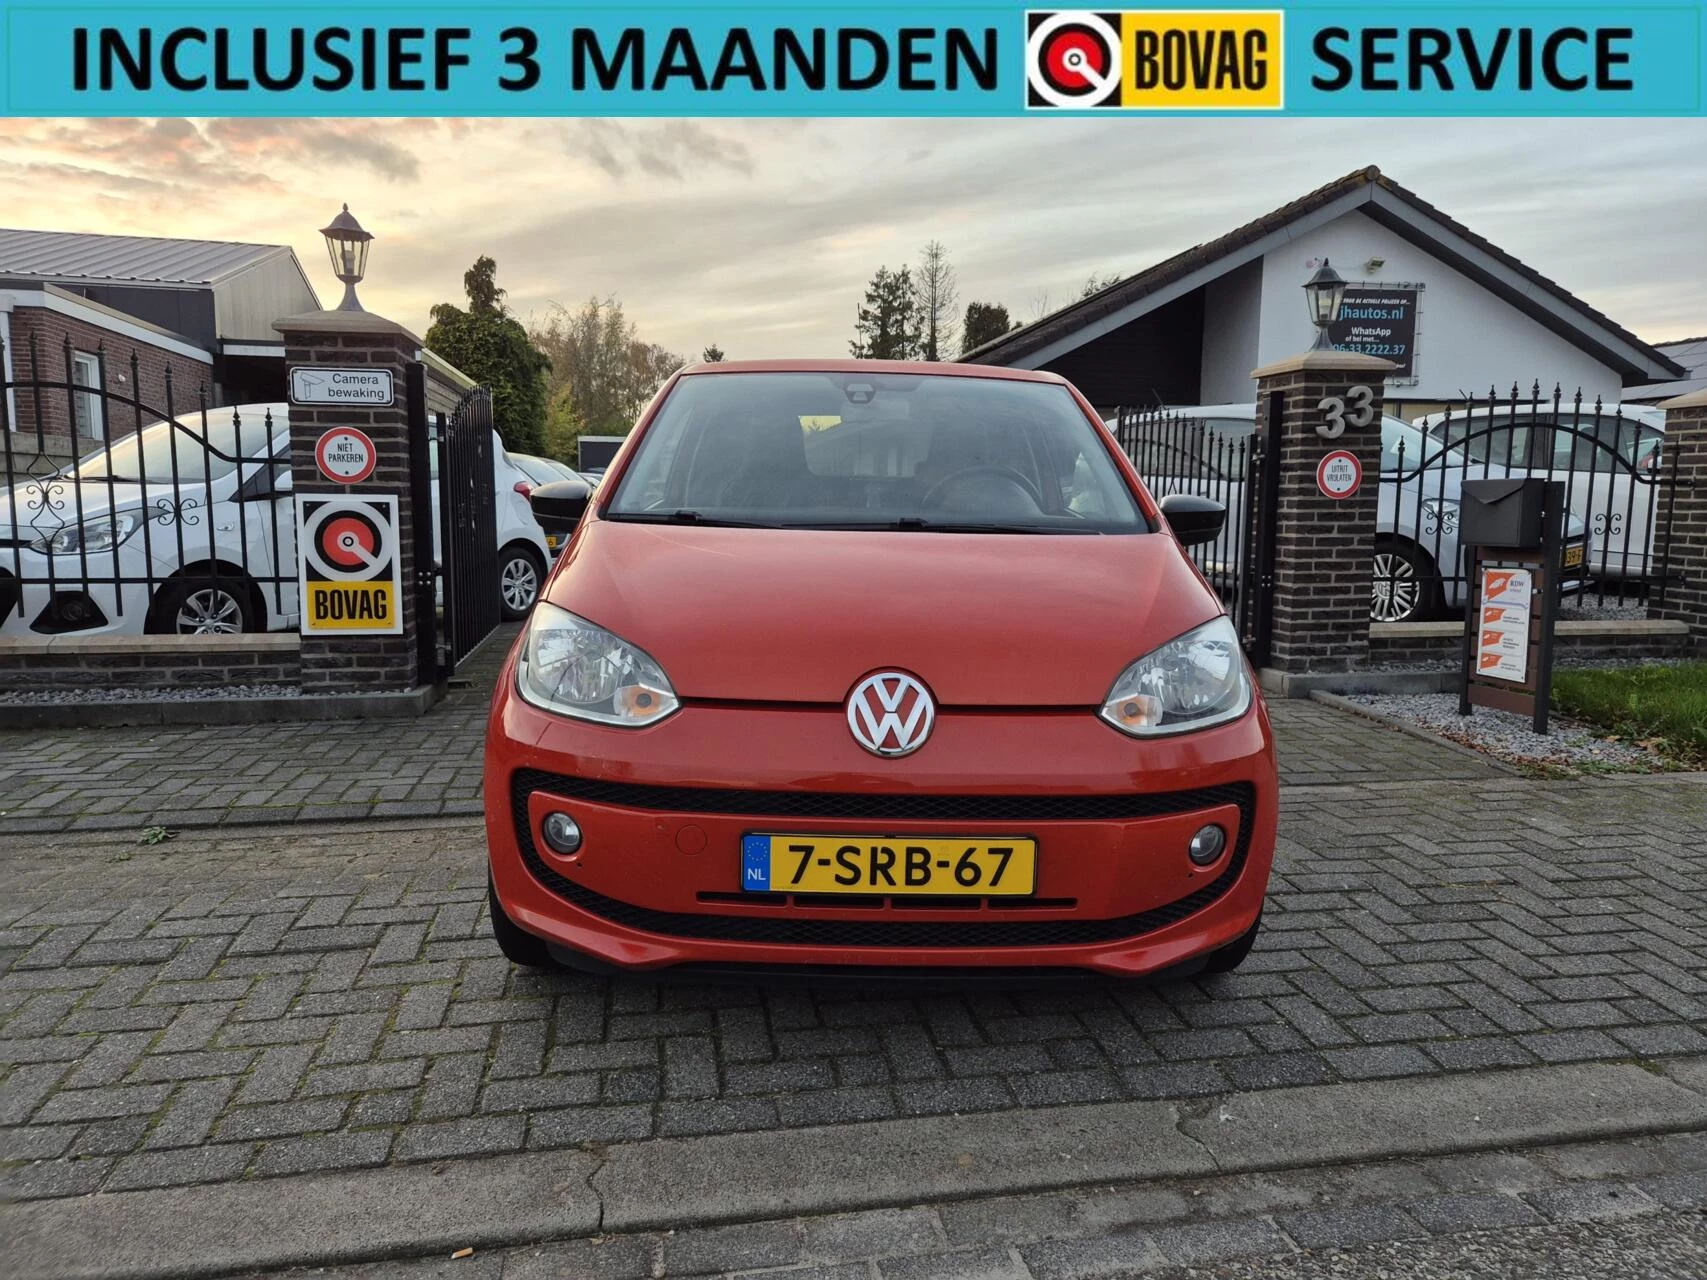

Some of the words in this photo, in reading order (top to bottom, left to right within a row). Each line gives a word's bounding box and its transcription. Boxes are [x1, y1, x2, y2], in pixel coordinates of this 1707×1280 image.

[1339, 305, 1404, 321] jhautos.nl
[1351, 326, 1391, 337] WhatsApp
[332, 373, 379, 385] Camera
[328, 387, 385, 401] bewaking
[1315, 385, 1374, 439] 33
[337, 443, 353, 452] NIET
[328, 453, 364, 463] PARKEREN
[314, 589, 387, 620] BOVAG
[788, 845, 1014, 887] 7-SRB-67
[747, 868, 766, 881] NL
